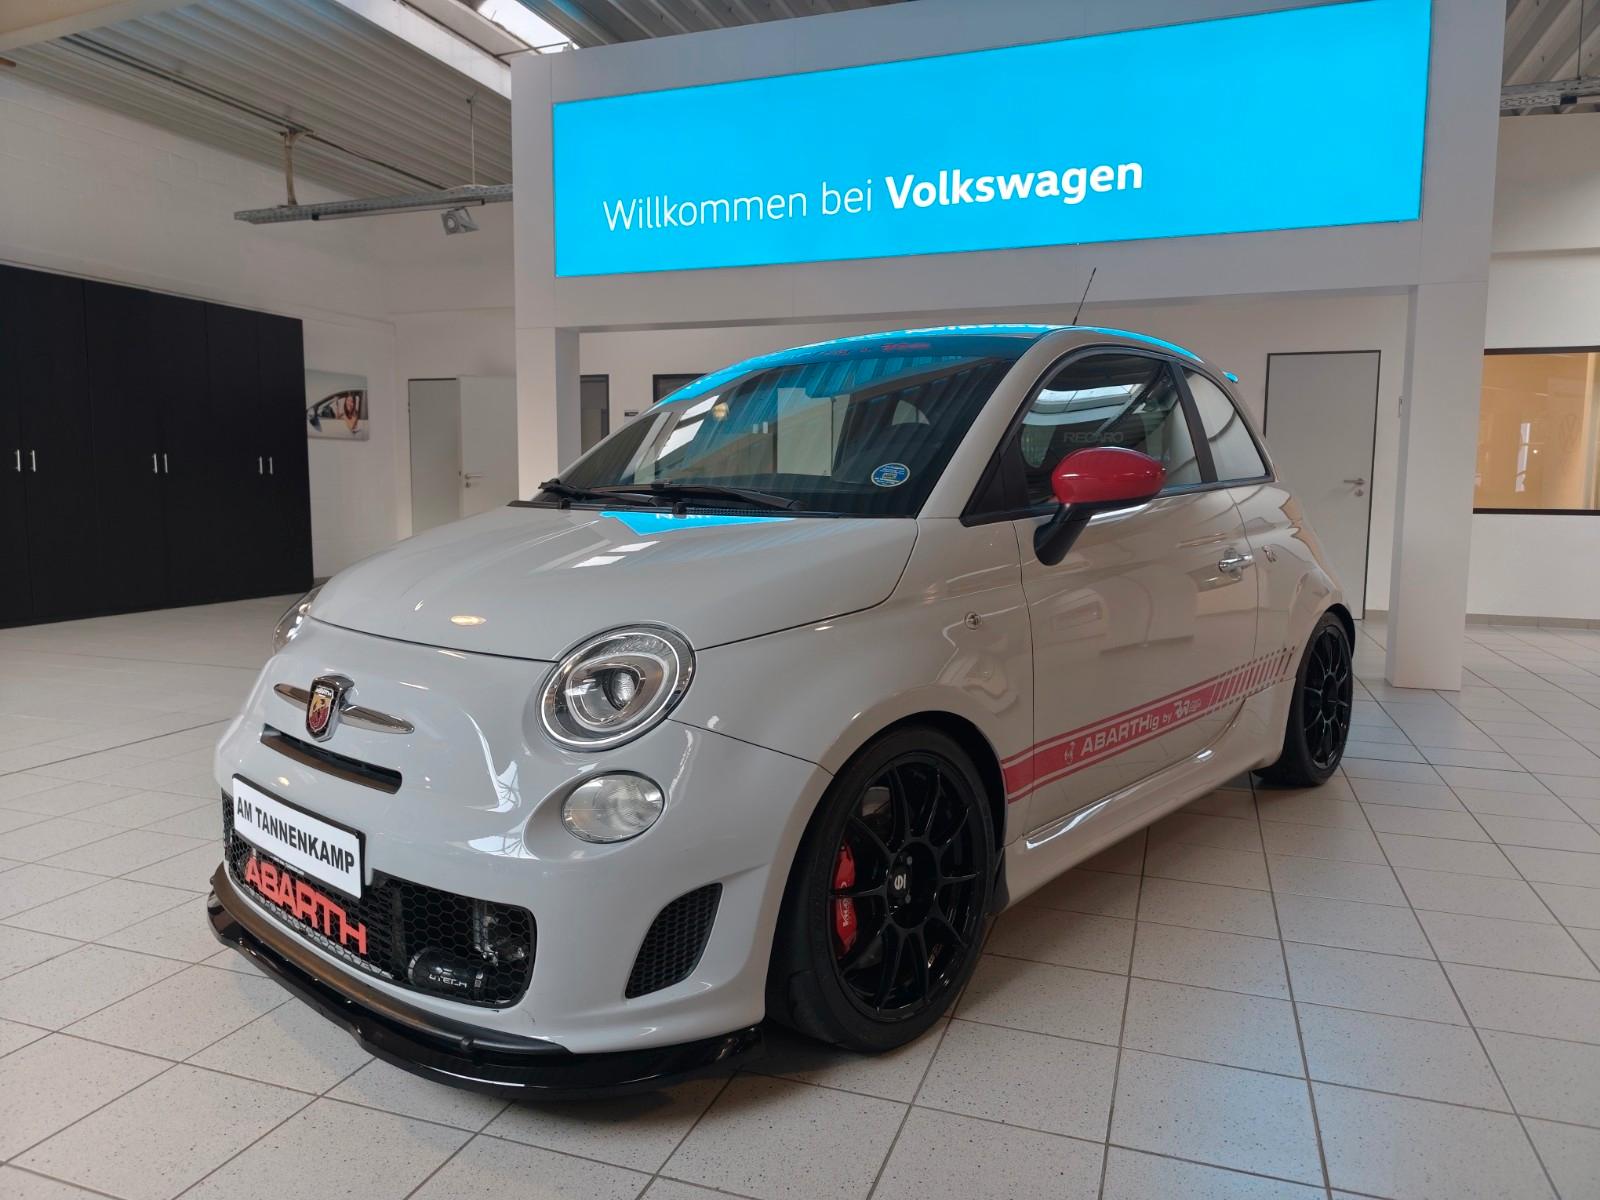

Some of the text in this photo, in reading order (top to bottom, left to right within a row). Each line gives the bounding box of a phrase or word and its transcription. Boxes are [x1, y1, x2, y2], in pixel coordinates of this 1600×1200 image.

[602, 161, 1144, 232] Willkommen bei Volkswagen
[236, 796, 356, 875] AM TANNENKAMP
[244, 855, 368, 955] ABARTH
